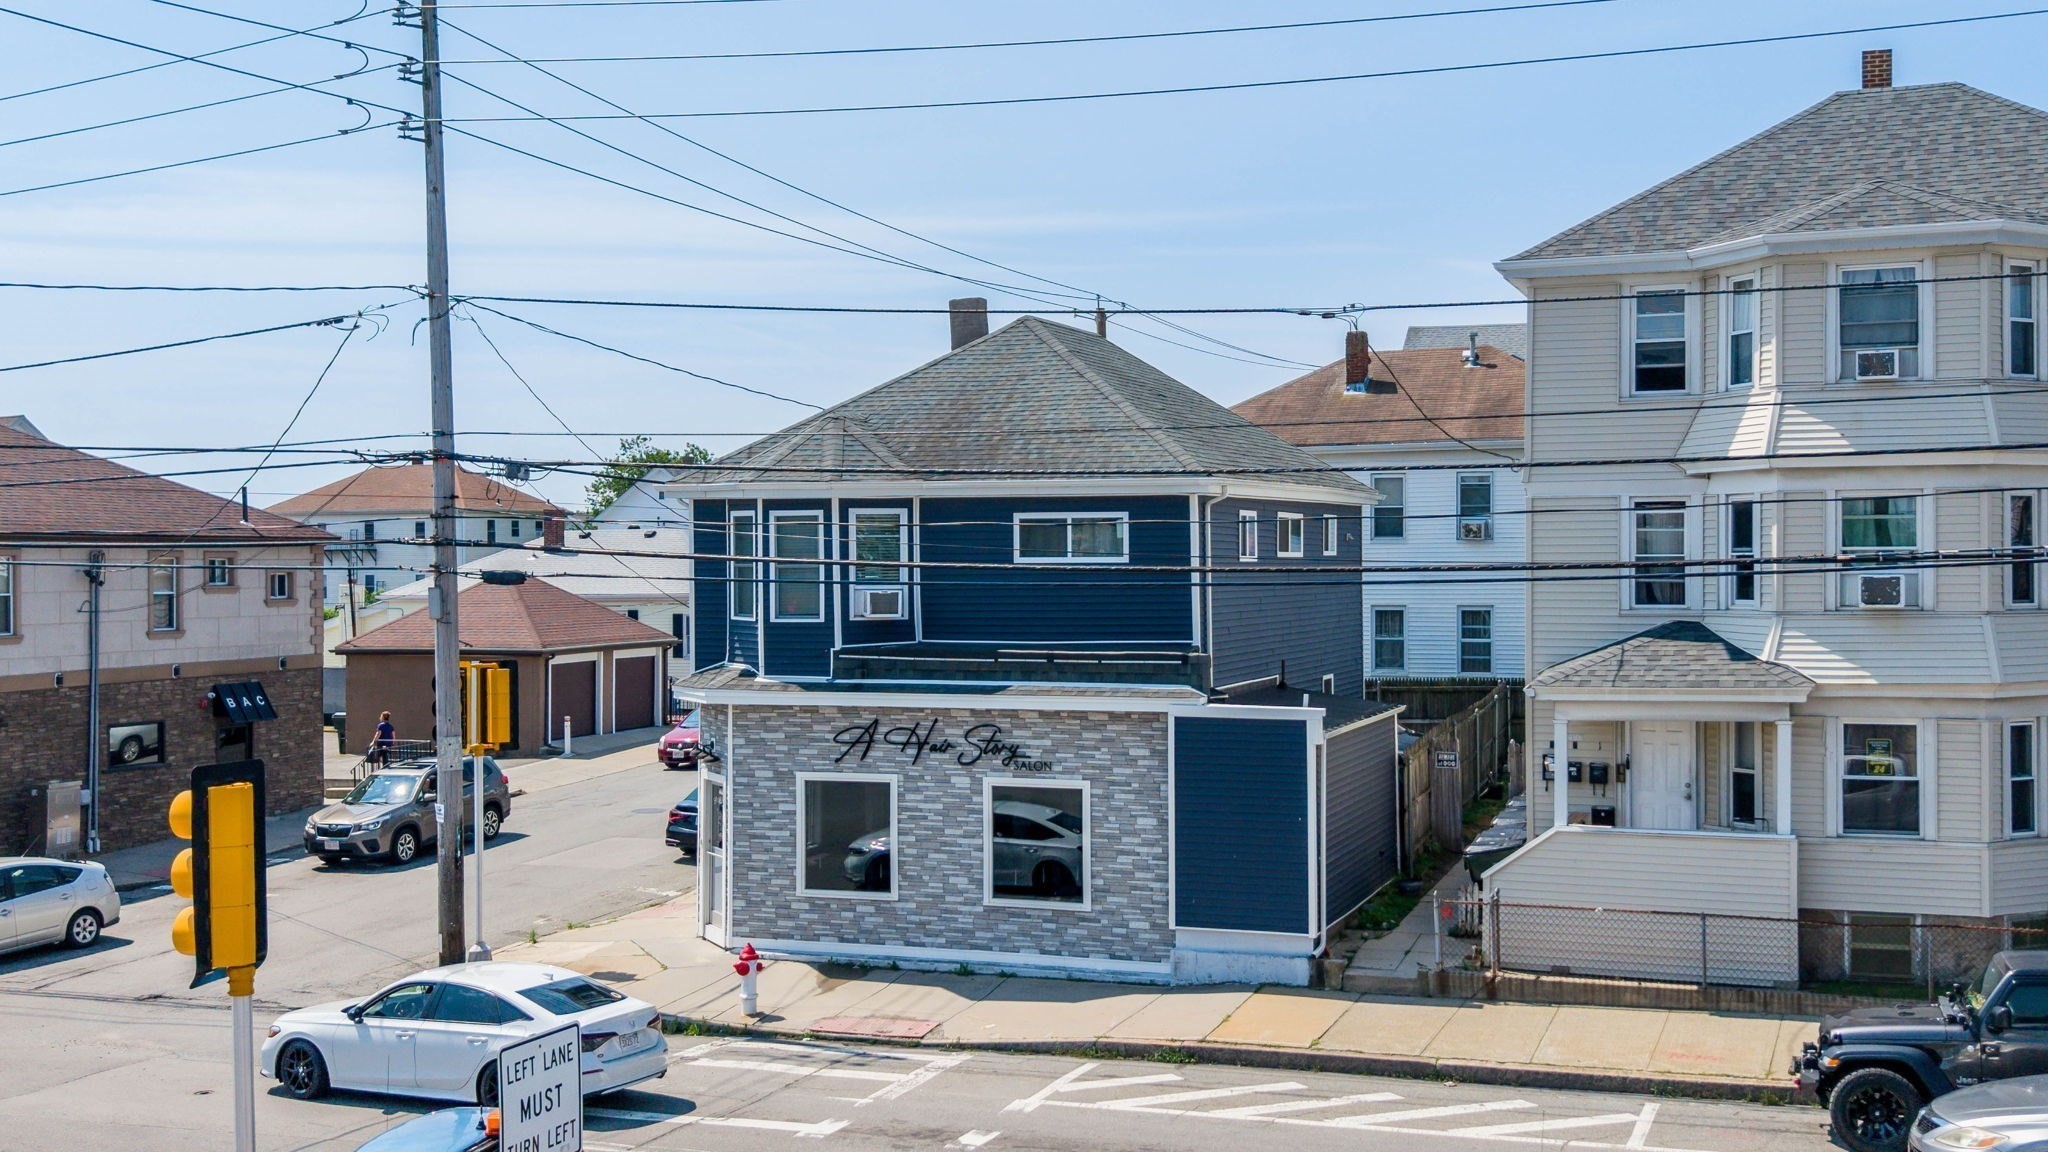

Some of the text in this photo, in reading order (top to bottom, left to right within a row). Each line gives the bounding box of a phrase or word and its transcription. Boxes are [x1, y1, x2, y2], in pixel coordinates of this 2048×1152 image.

[226, 695, 265, 708] BAC
[833, 718, 1031, 767] A Hair Story
[1013, 760, 1052, 772] SALON
[506, 1042, 574, 1085] LEFT LANE
[520, 1083, 563, 1123] MUST
[548, 1119, 576, 1149] LEFT
